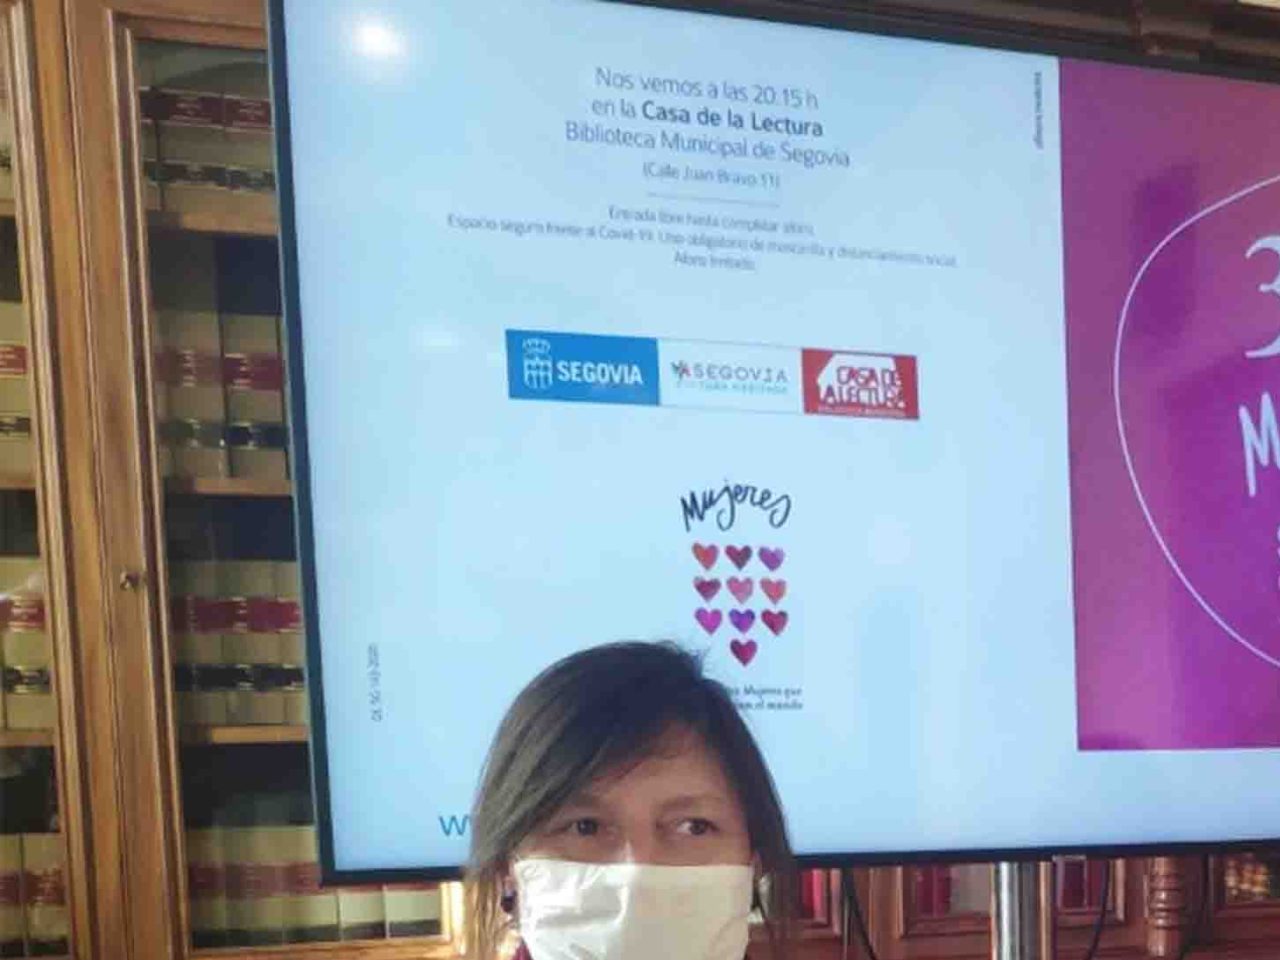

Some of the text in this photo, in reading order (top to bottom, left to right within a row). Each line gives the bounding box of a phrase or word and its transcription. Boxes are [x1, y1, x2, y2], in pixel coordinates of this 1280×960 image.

[595, 67, 634, 90] Nos
[640, 75, 701, 97] vemos
[708, 83, 718, 99] a
[723, 81, 748, 101] las
[592, 99, 823, 137] en la Casa de la Lectura
[566, 120, 850, 169] Biblioteca Municipal de Segovia
[683, 165, 714, 182] Juan
[556, 359, 643, 385] SEGOVIA
[693, 363, 788, 383] SEGOVIA
[681, 478, 791, 532] Mujeres
